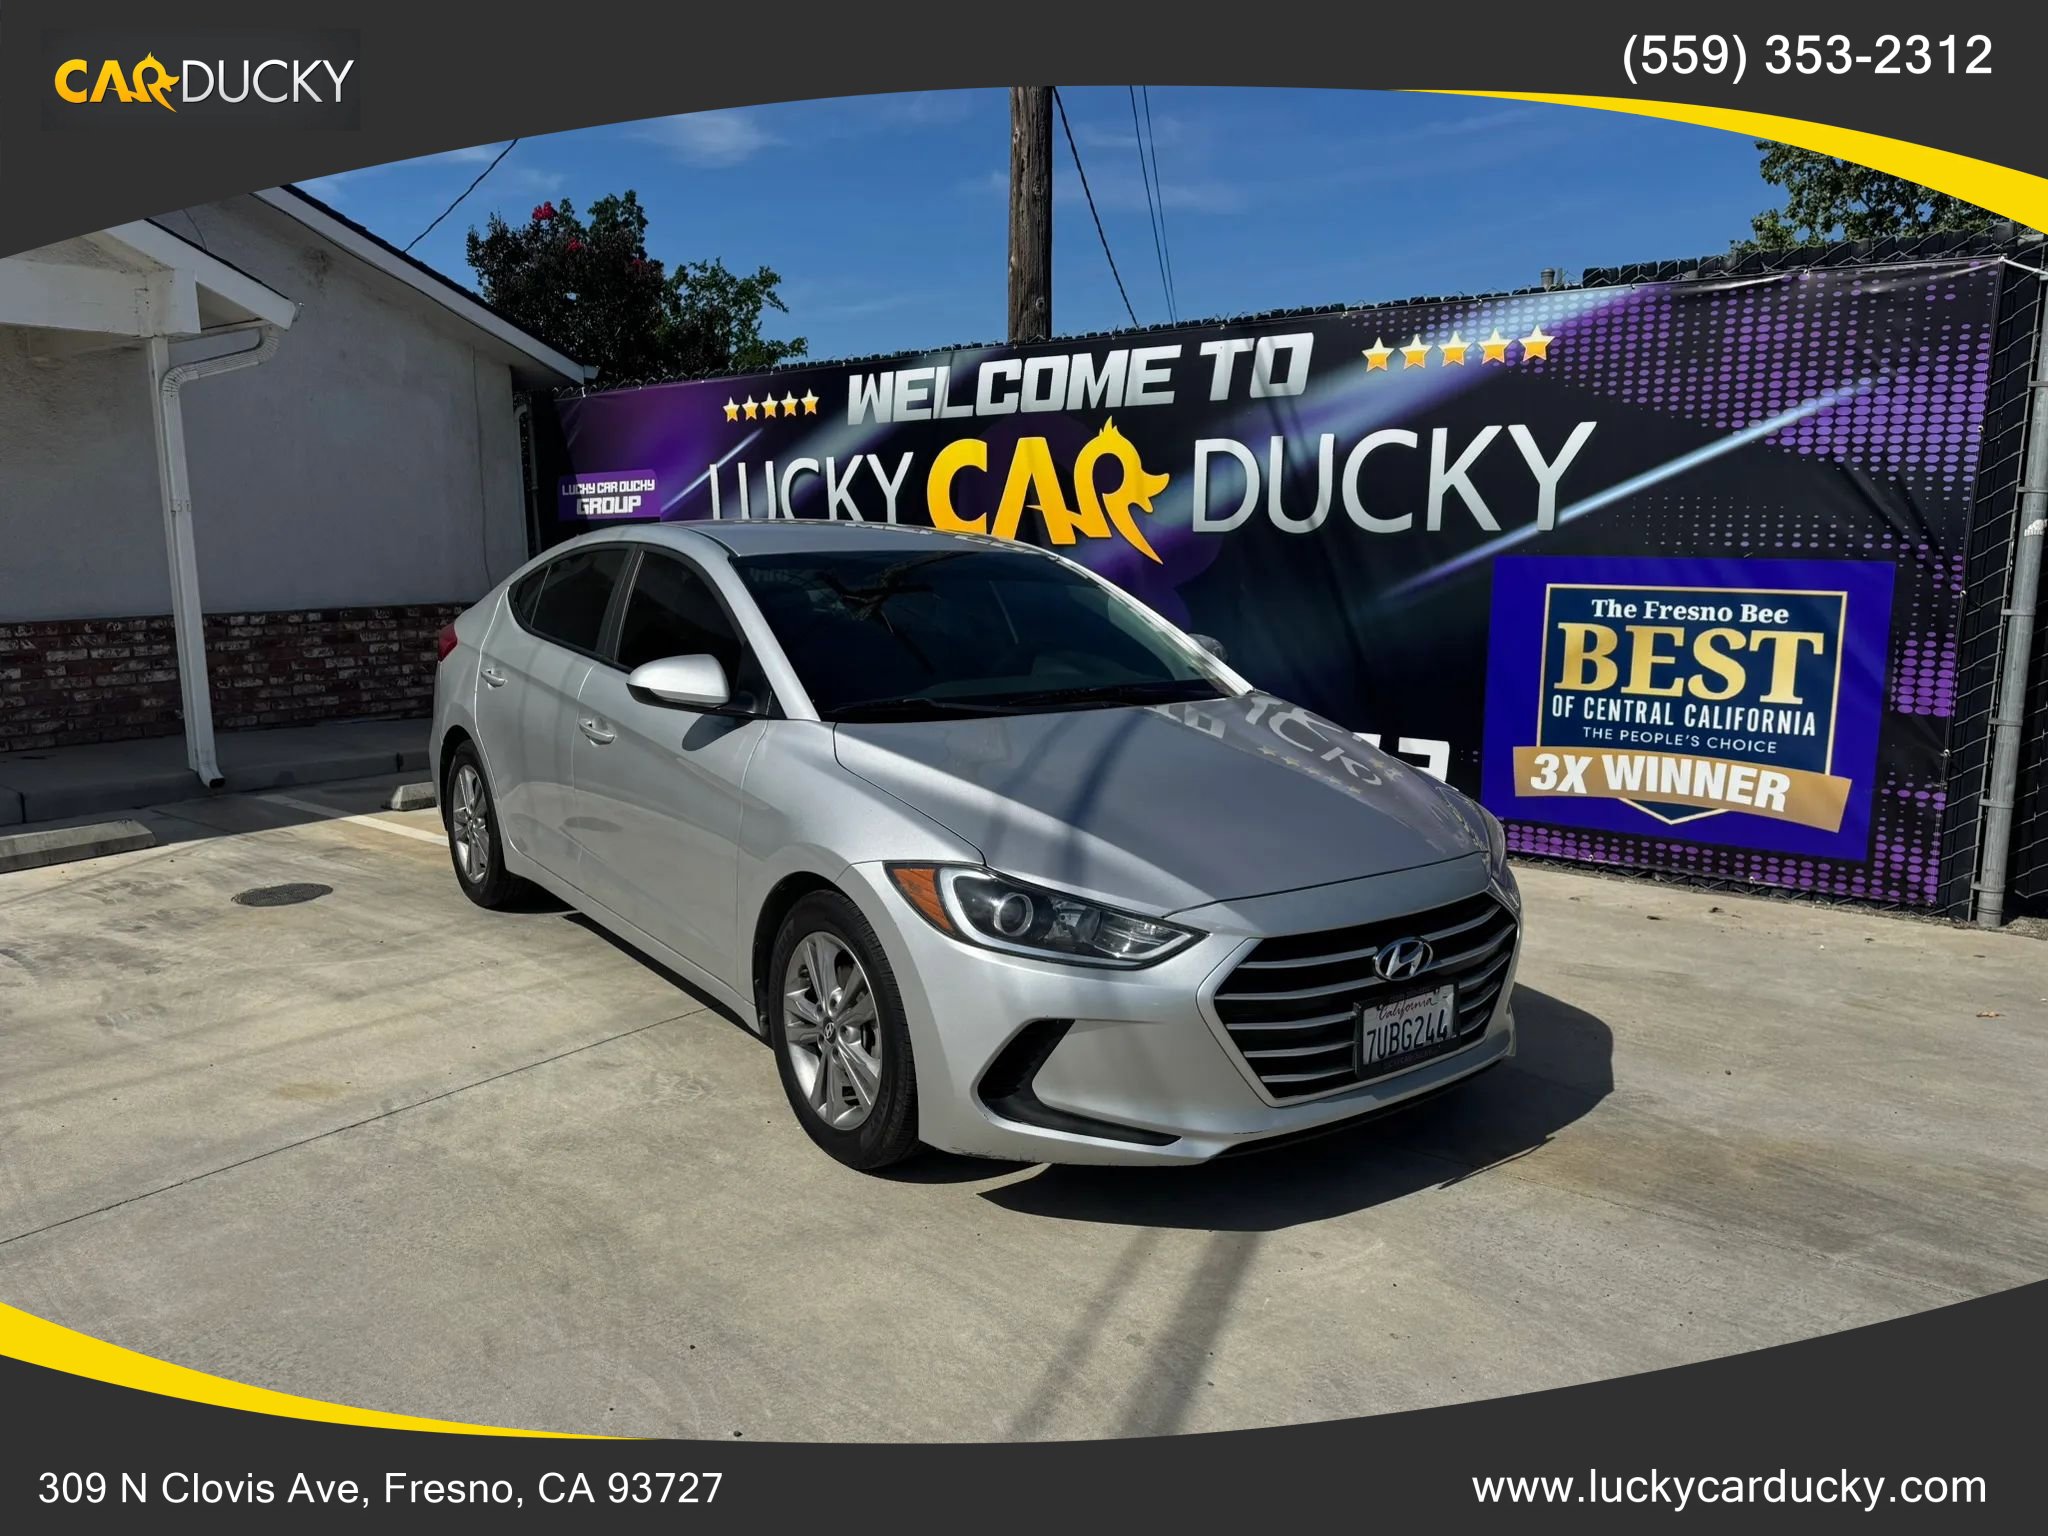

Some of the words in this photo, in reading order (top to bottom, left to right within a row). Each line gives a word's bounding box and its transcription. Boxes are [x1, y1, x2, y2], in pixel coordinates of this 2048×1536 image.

[848, 344, 1182, 425] WELCOME
[1200, 332, 1314, 402] TO
[577, 495, 641, 515] GROUP
[597, 481, 618, 494] CAR
[926, 416, 1170, 565] CAR
[1192, 421, 1597, 533] DUCKY
[1592, 599, 1637, 620] The
[1643, 601, 1733, 623] Fresno
[1740, 604, 1790, 625] Bee
[1554, 622, 1824, 704] BEST
[1552, 694, 1574, 718] OF
[1584, 696, 1674, 727] CENTRAL
[1684, 703, 1816, 737] CALIFORNIA
[1583, 727, 1612, 740] THE
[1619, 729, 1700, 747] PEOPLE'S
[1707, 737, 1777, 754] CHOICE
[1530, 753, 1593, 794] 3X
[1602, 754, 1791, 812] WINNER
[1378, 997, 1437, 1021] California
[1367, 1009, 1448, 1064] 7UBG244
